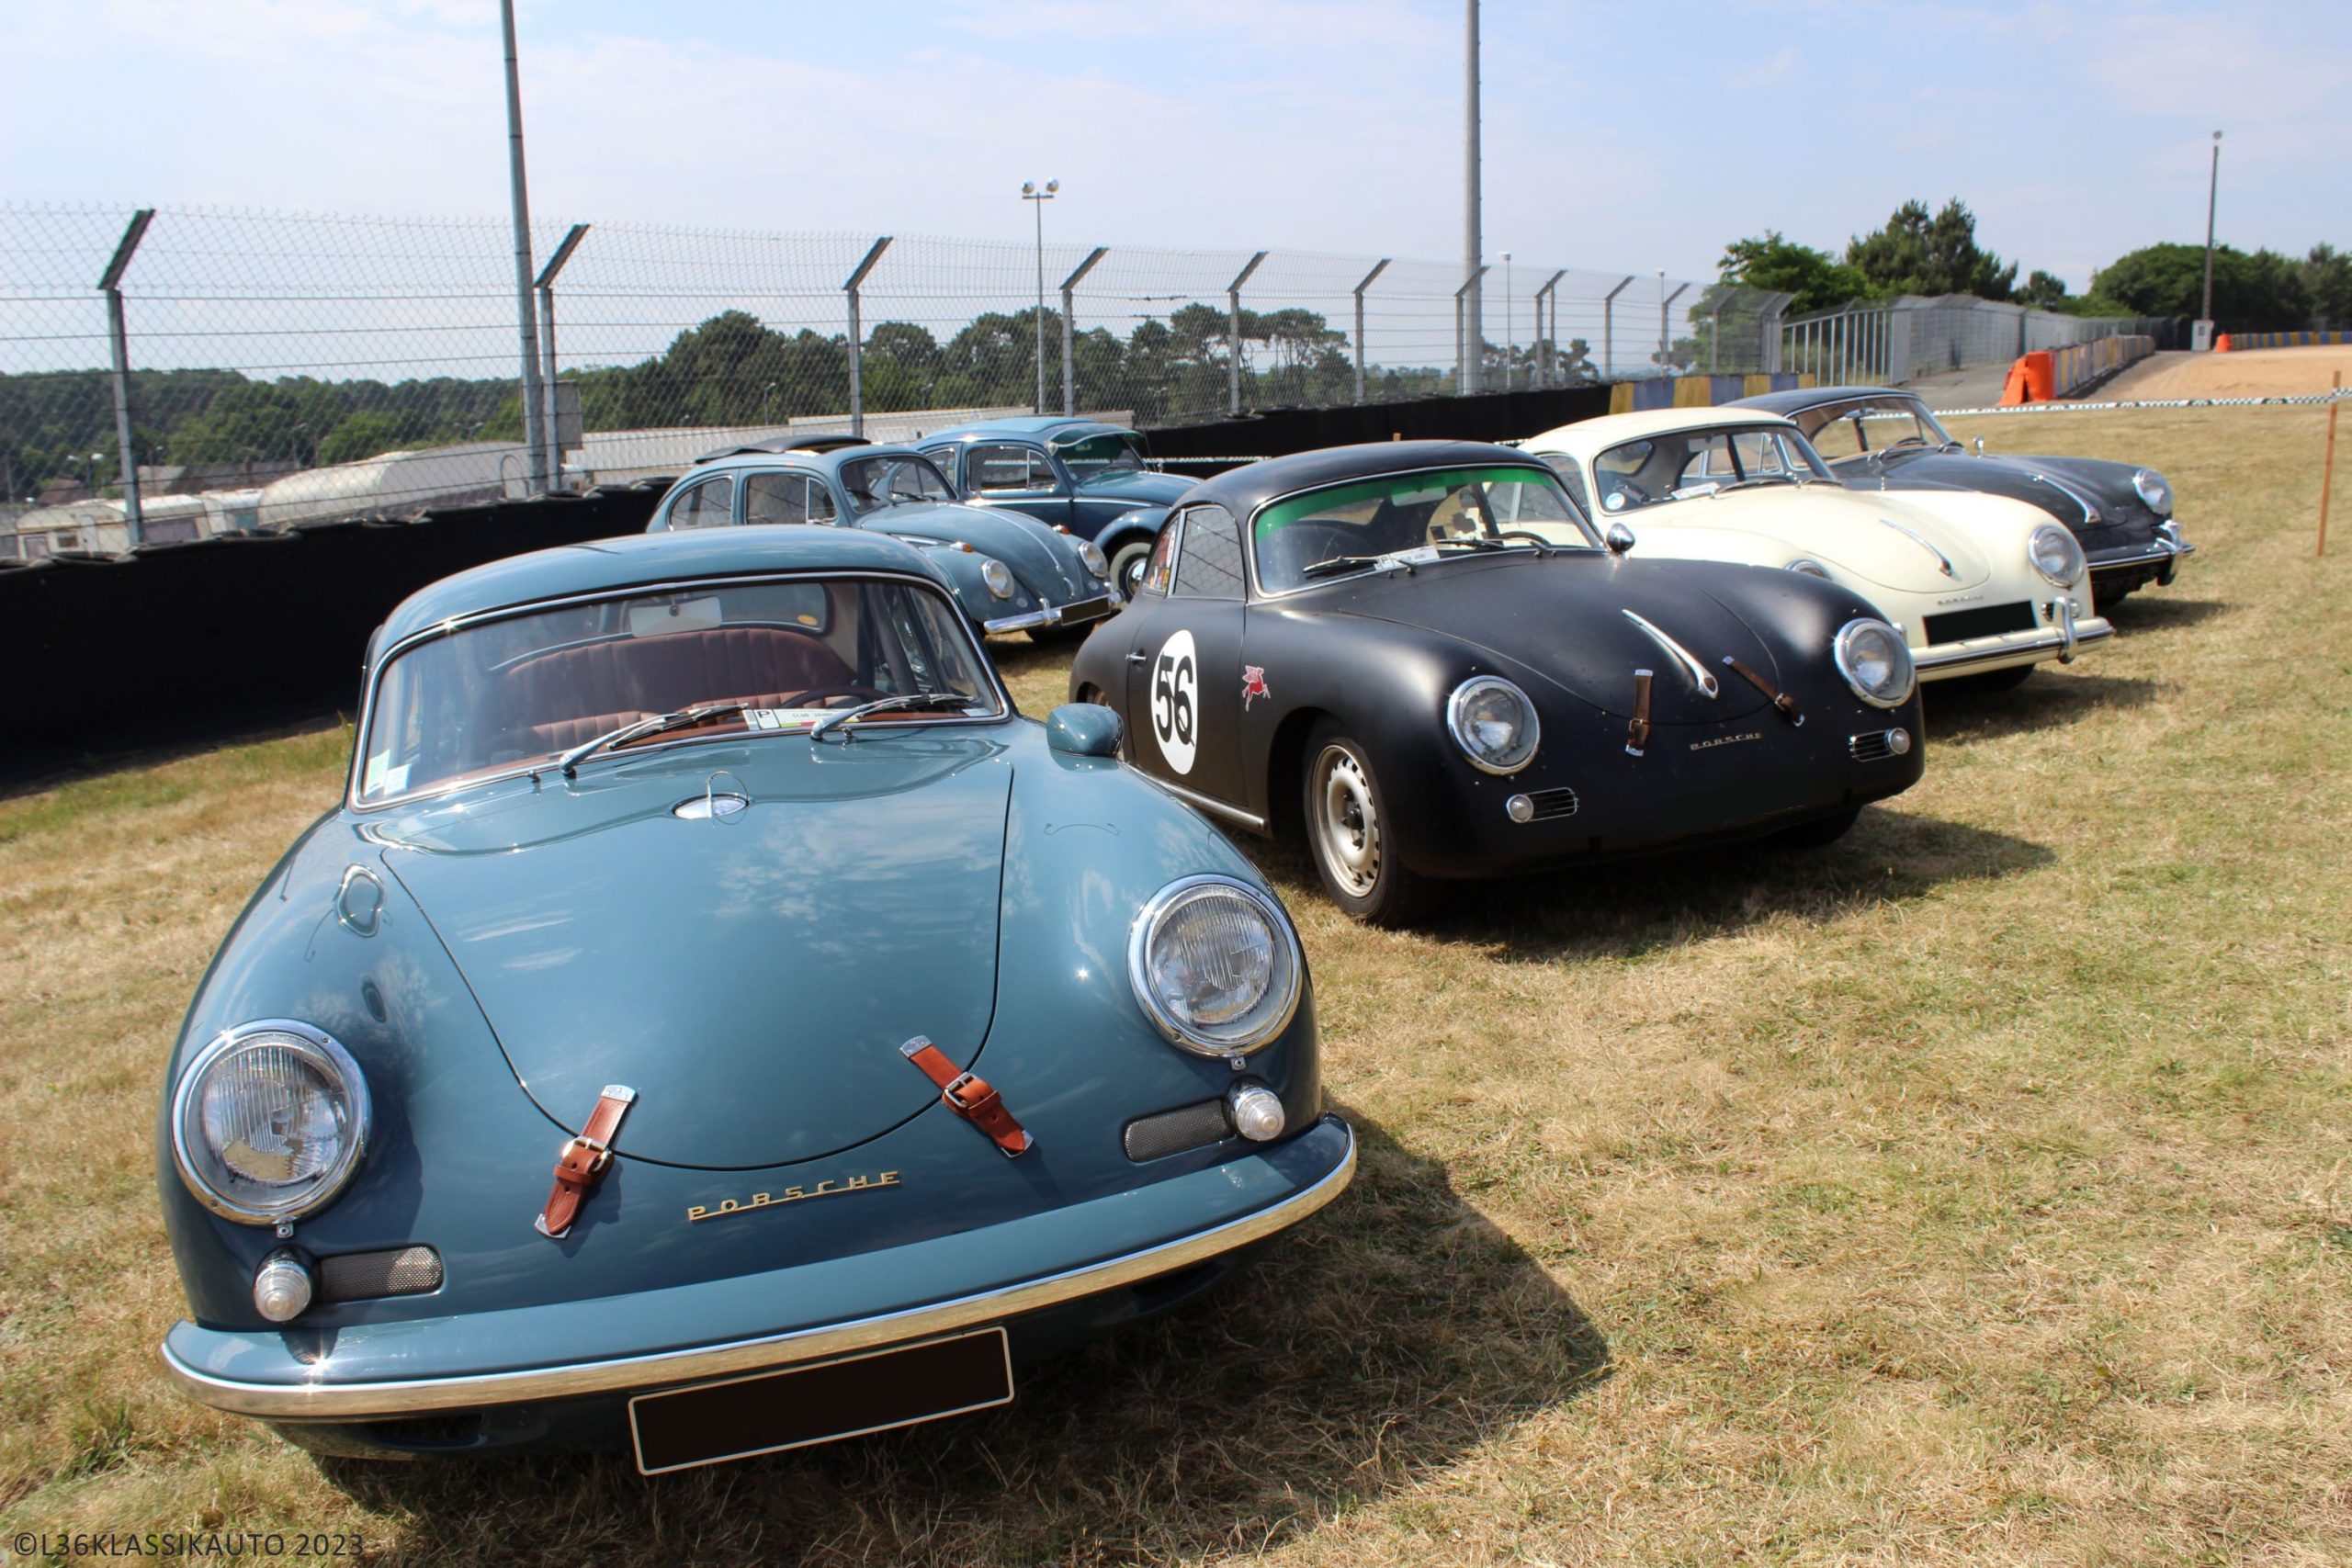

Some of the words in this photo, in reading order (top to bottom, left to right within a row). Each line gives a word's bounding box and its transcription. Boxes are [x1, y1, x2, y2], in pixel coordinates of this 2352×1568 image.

[757, 710, 770, 718] P
[1156, 652, 1193, 746] 56
[1690, 732, 1763, 750] PORSCHE
[687, 1171, 900, 1221] PORSCHE
